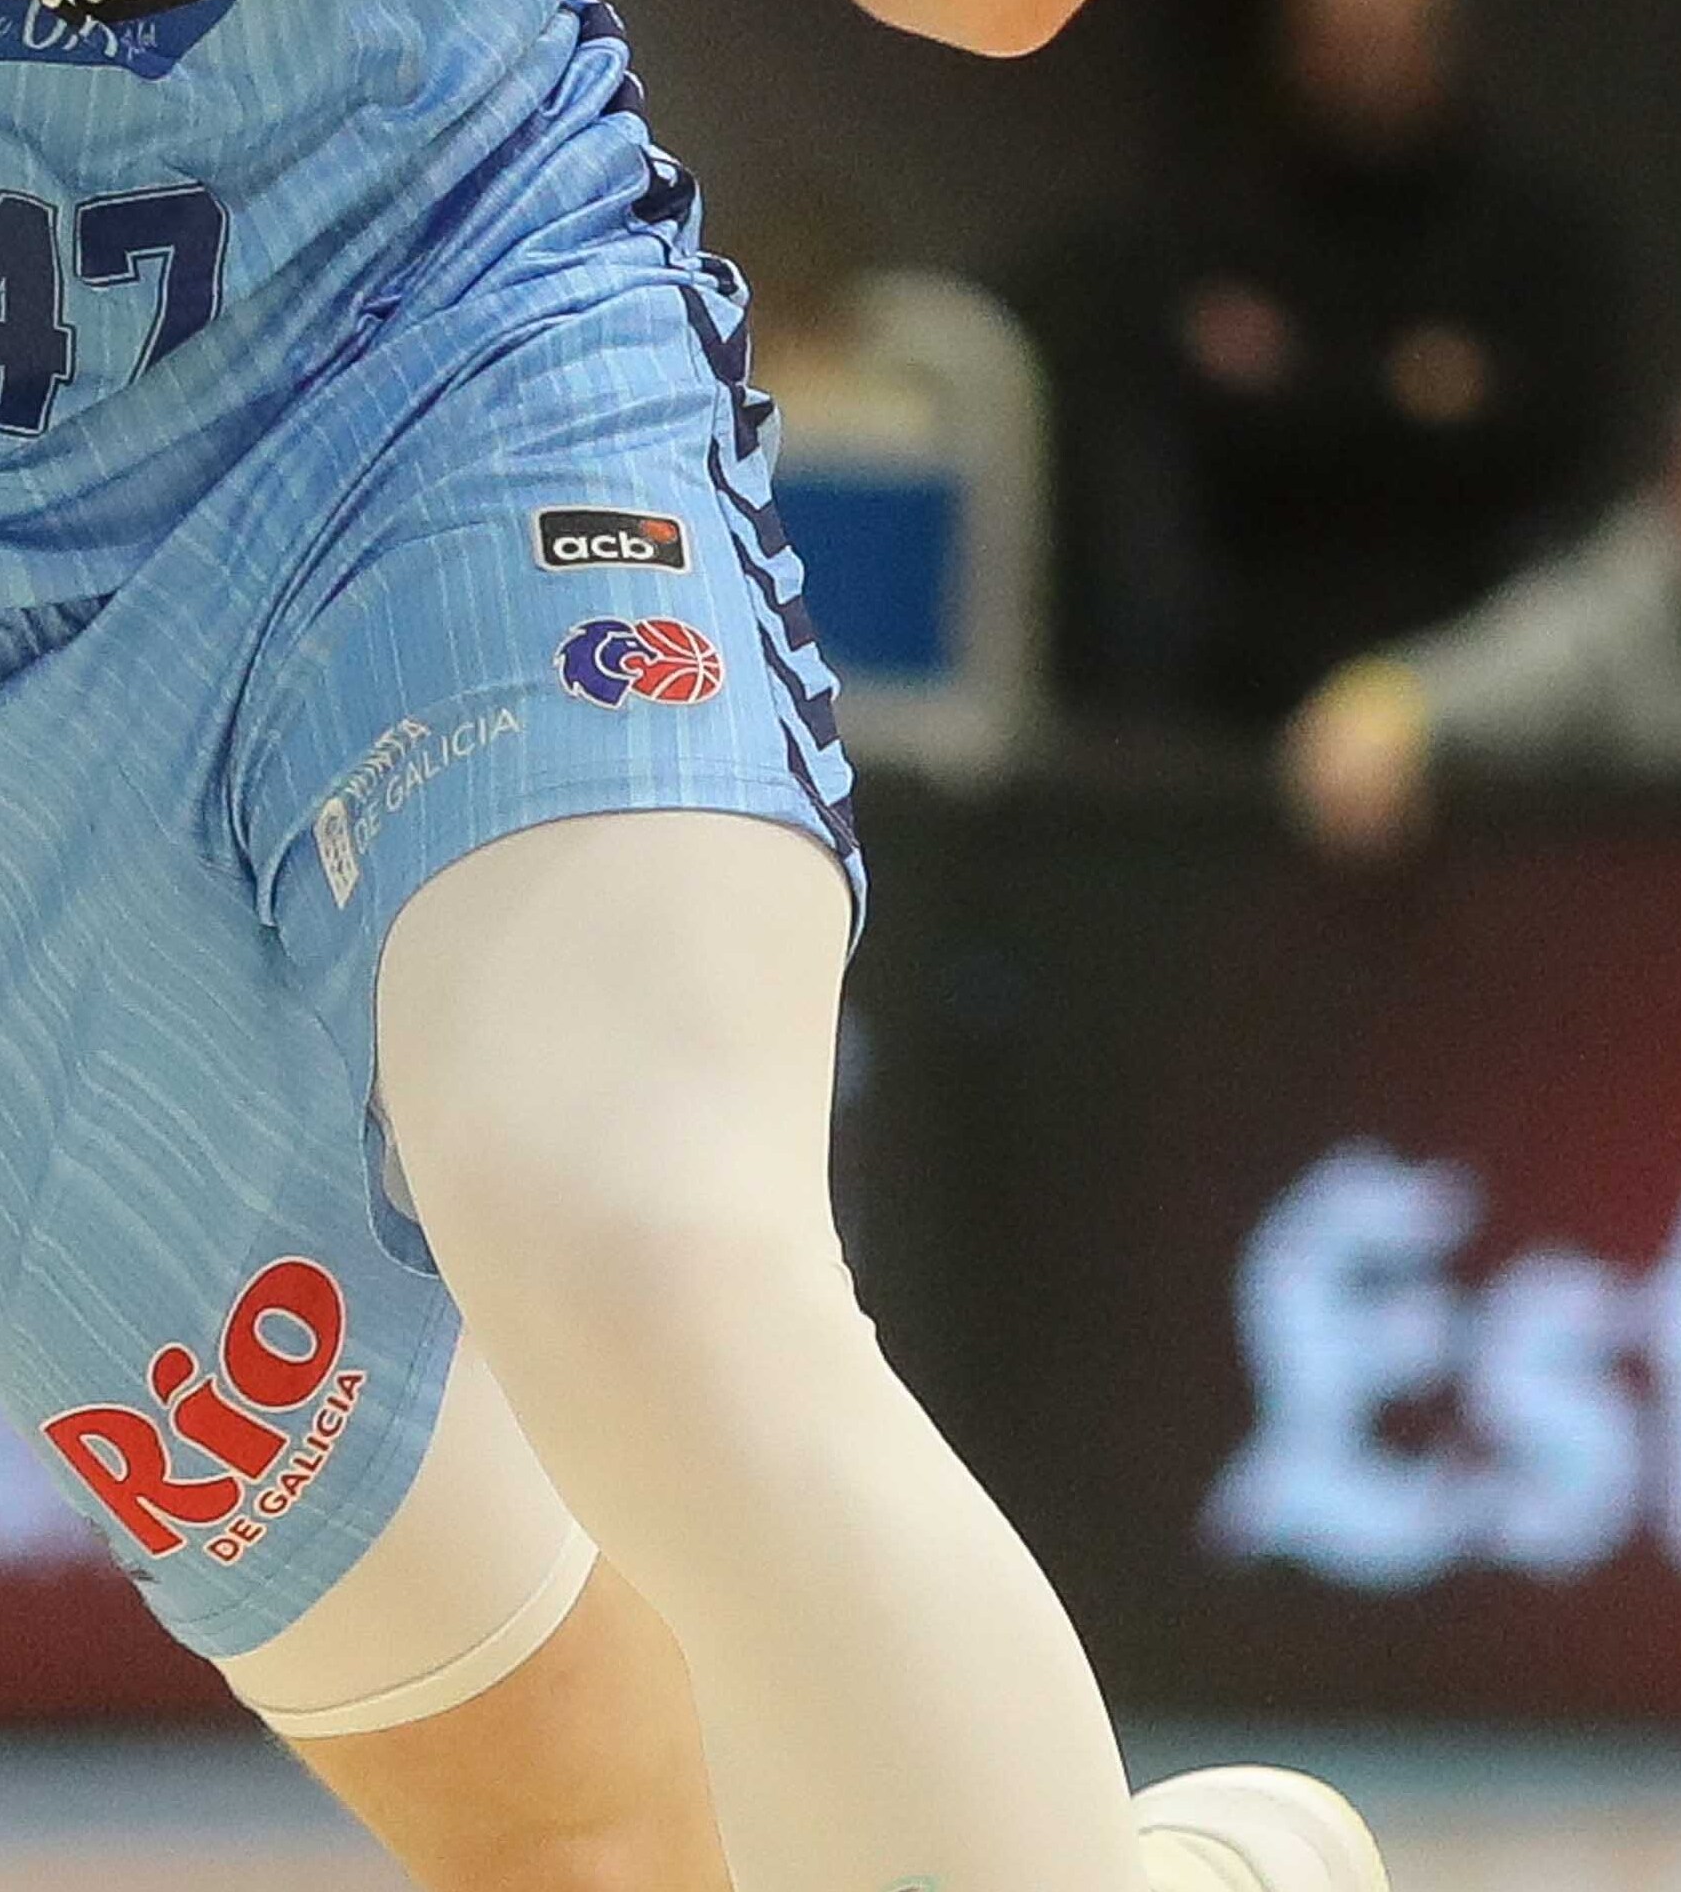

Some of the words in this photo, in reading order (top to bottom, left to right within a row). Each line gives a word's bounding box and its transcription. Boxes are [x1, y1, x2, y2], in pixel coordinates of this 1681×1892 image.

[553, 531, 655, 561] acb
[386, 707, 522, 813] GALICIA
[203, 1514, 268, 1565] DE
[256, 1369, 367, 1518] GALICIA
